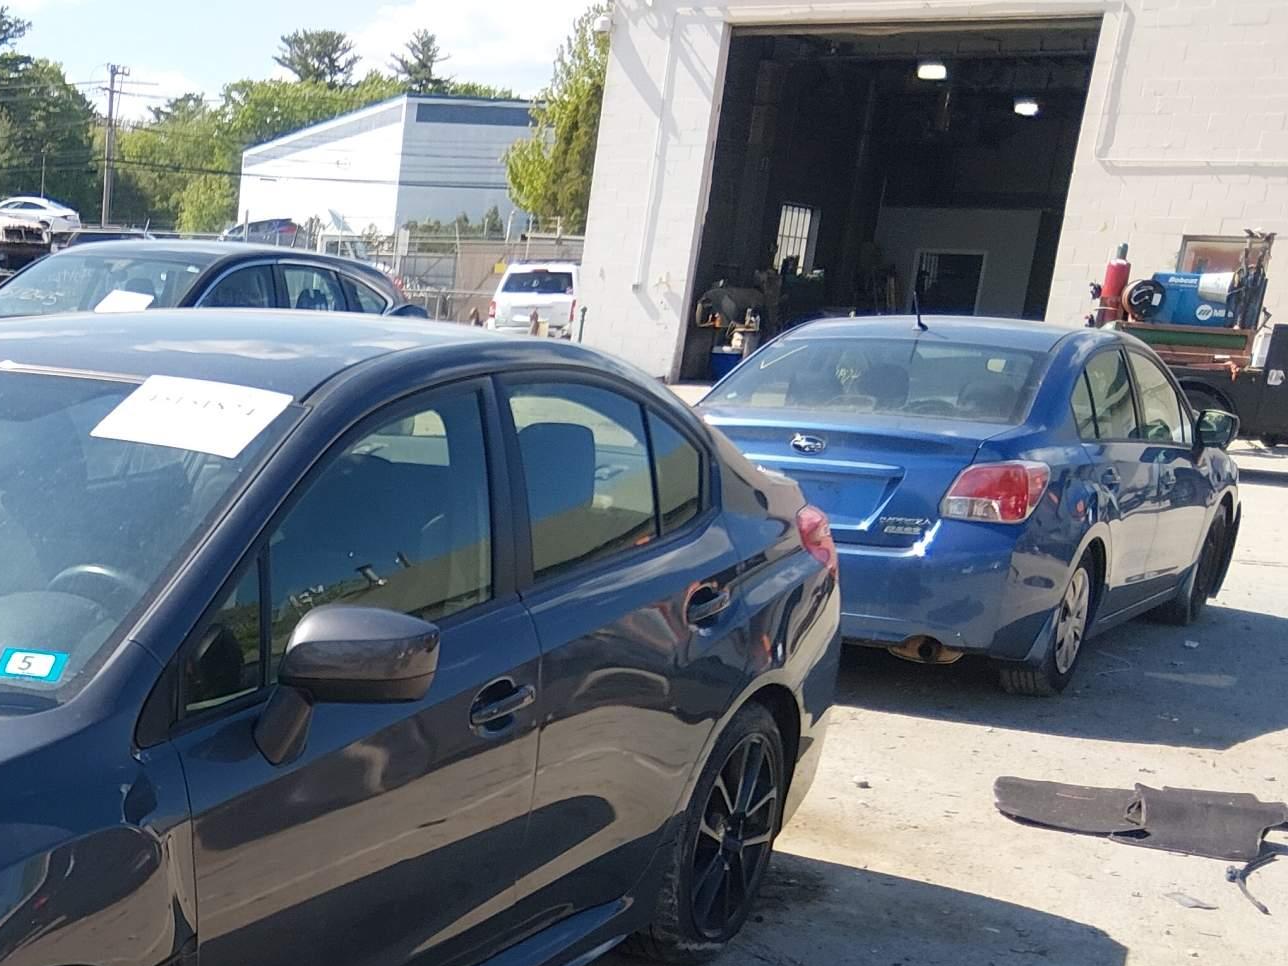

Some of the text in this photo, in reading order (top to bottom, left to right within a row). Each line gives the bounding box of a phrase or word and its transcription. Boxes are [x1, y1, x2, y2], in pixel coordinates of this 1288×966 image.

[1168, 276, 1199, 285] Bobcat
[1213, 308, 1234, 318] Mile
[17, 655, 35, 671] 5
